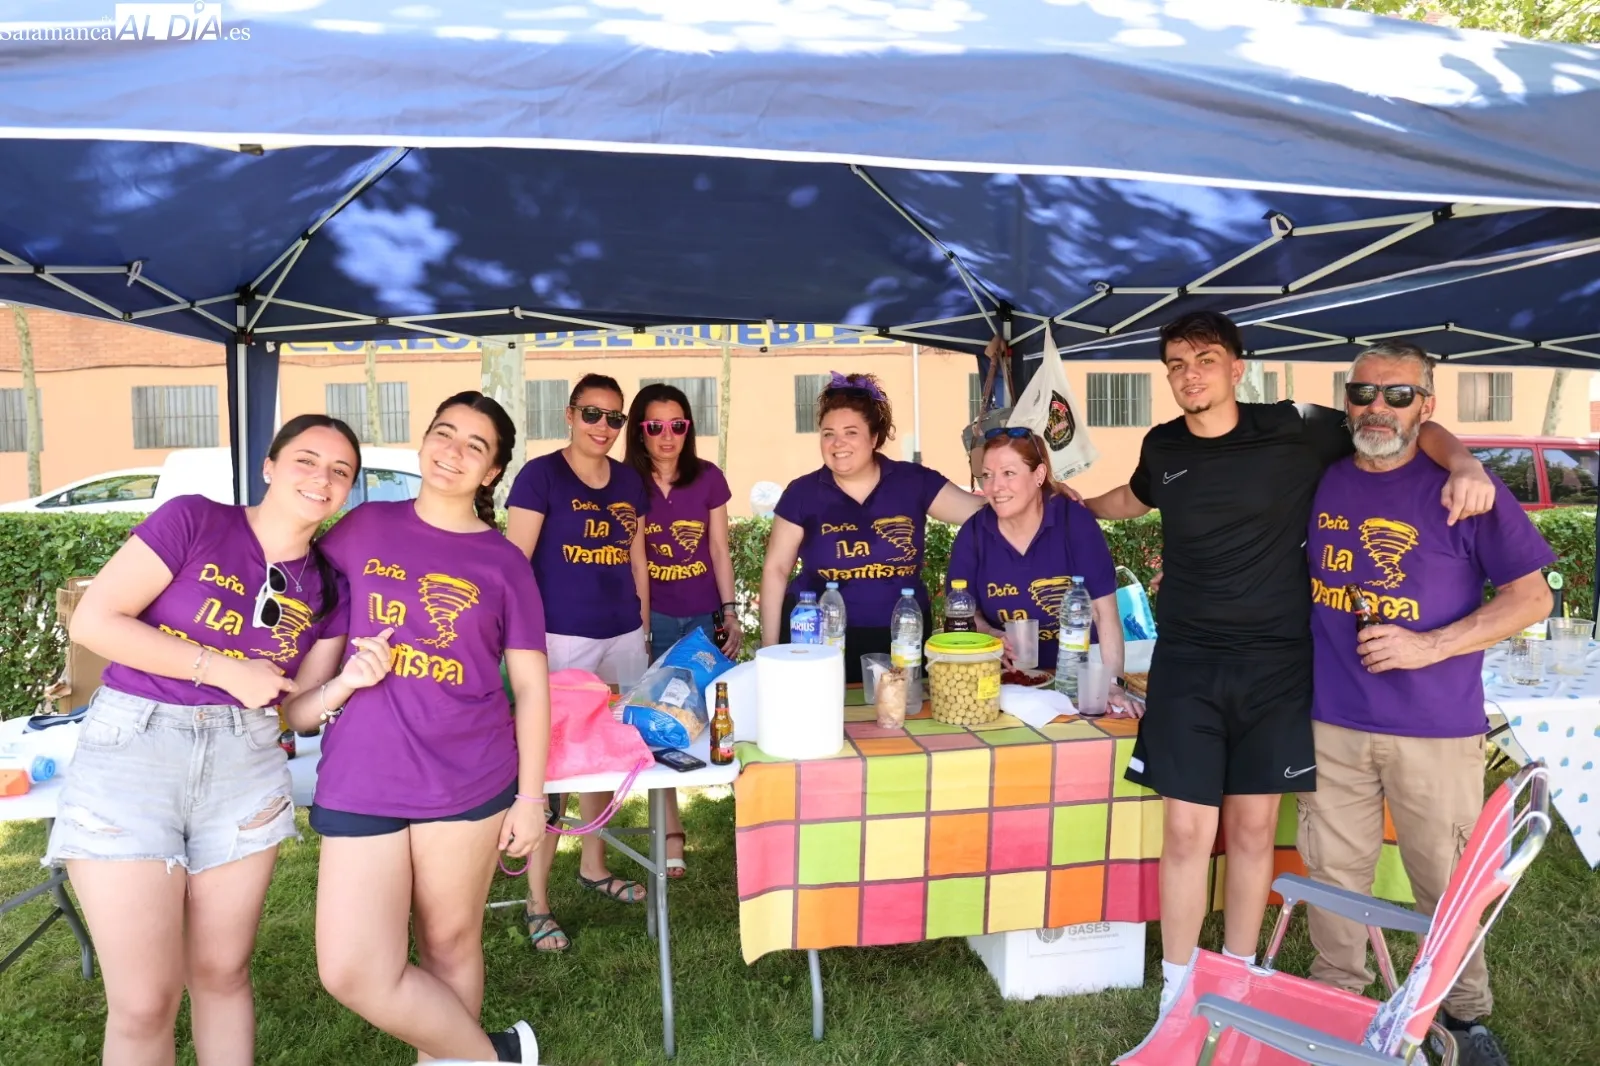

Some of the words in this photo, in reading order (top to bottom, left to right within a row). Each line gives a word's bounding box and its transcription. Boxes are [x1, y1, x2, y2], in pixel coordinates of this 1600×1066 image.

[583, 518, 610, 538] La
[645, 522, 663, 535] eña
[1318, 512, 1350, 531] Peña
[562, 544, 630, 566] Ventis
[835, 540, 871, 559] La
[1321, 544, 1354, 573] La
[199, 563, 246, 596] Peña
[363, 558, 407, 581] Peña
[647, 560, 708, 581] entisca
[367, 592, 407, 628] La
[1311, 577, 1420, 622] Ventsca
[193, 597, 245, 637] La
[1068, 922, 1111, 936] GASES
